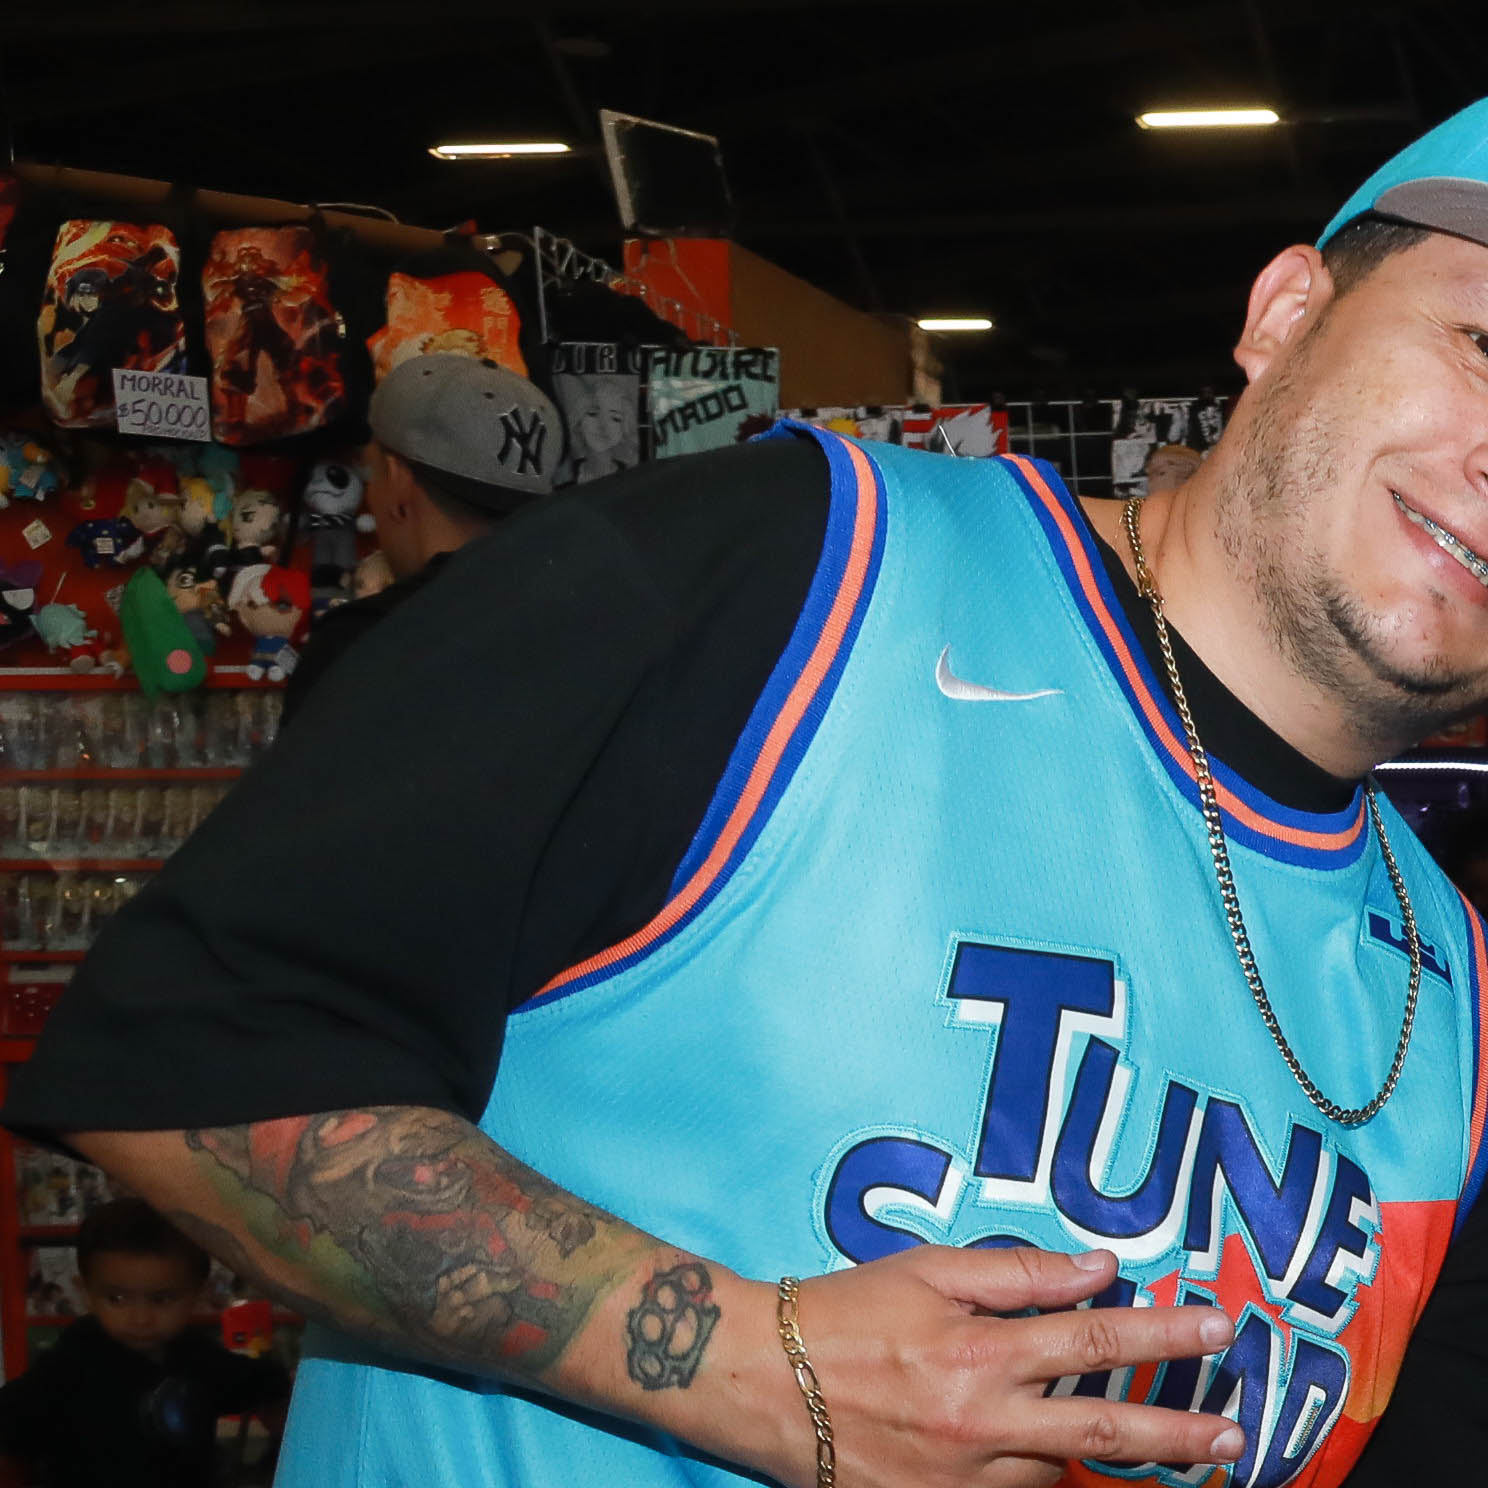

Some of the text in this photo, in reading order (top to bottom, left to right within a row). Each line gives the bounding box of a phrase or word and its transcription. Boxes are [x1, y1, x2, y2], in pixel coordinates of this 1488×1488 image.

[120, 374, 201, 400] MORRAL
[497, 403, 547, 477] NY
[948, 942, 1377, 1325] TUNE
